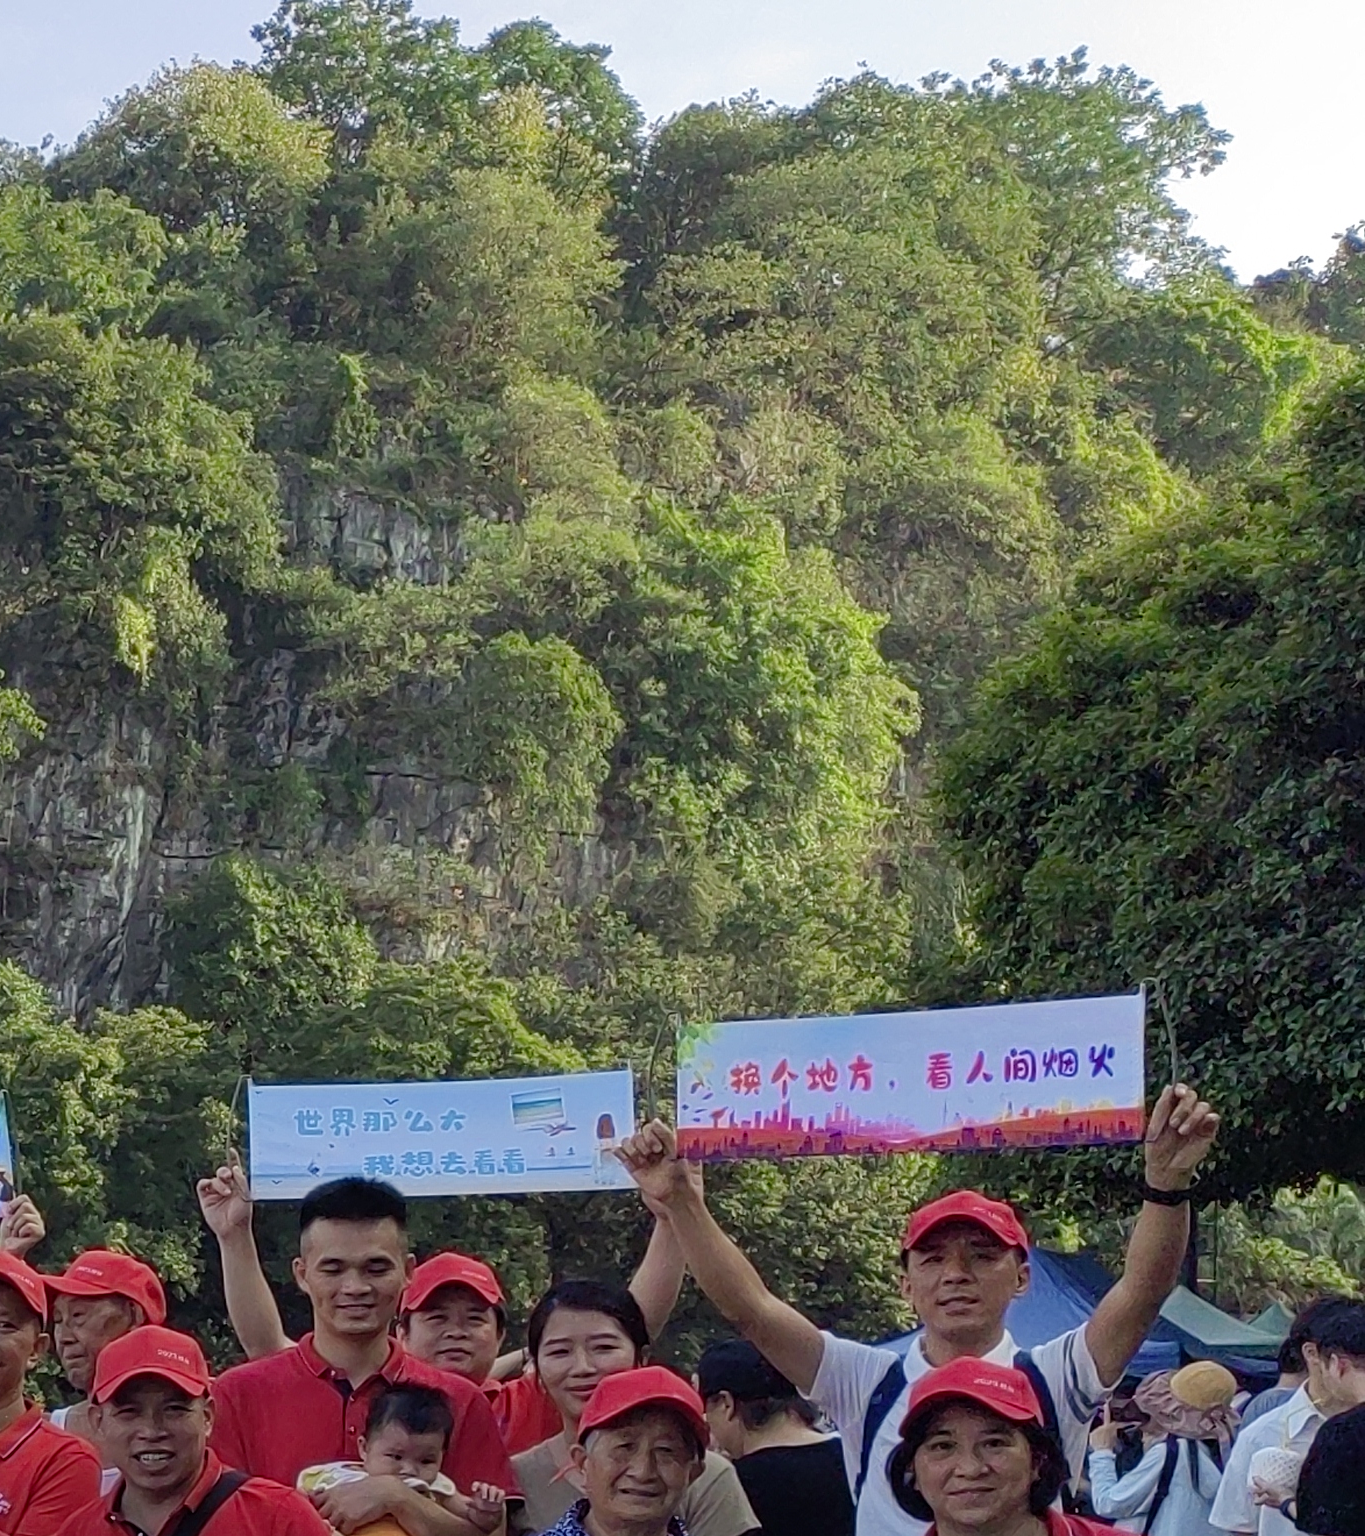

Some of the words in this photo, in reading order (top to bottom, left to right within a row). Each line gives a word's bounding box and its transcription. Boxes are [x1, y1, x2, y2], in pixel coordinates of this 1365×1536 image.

[293, 1108, 468, 1137] 世界那么大
[362, 1147, 527, 1179] 我想去看看
